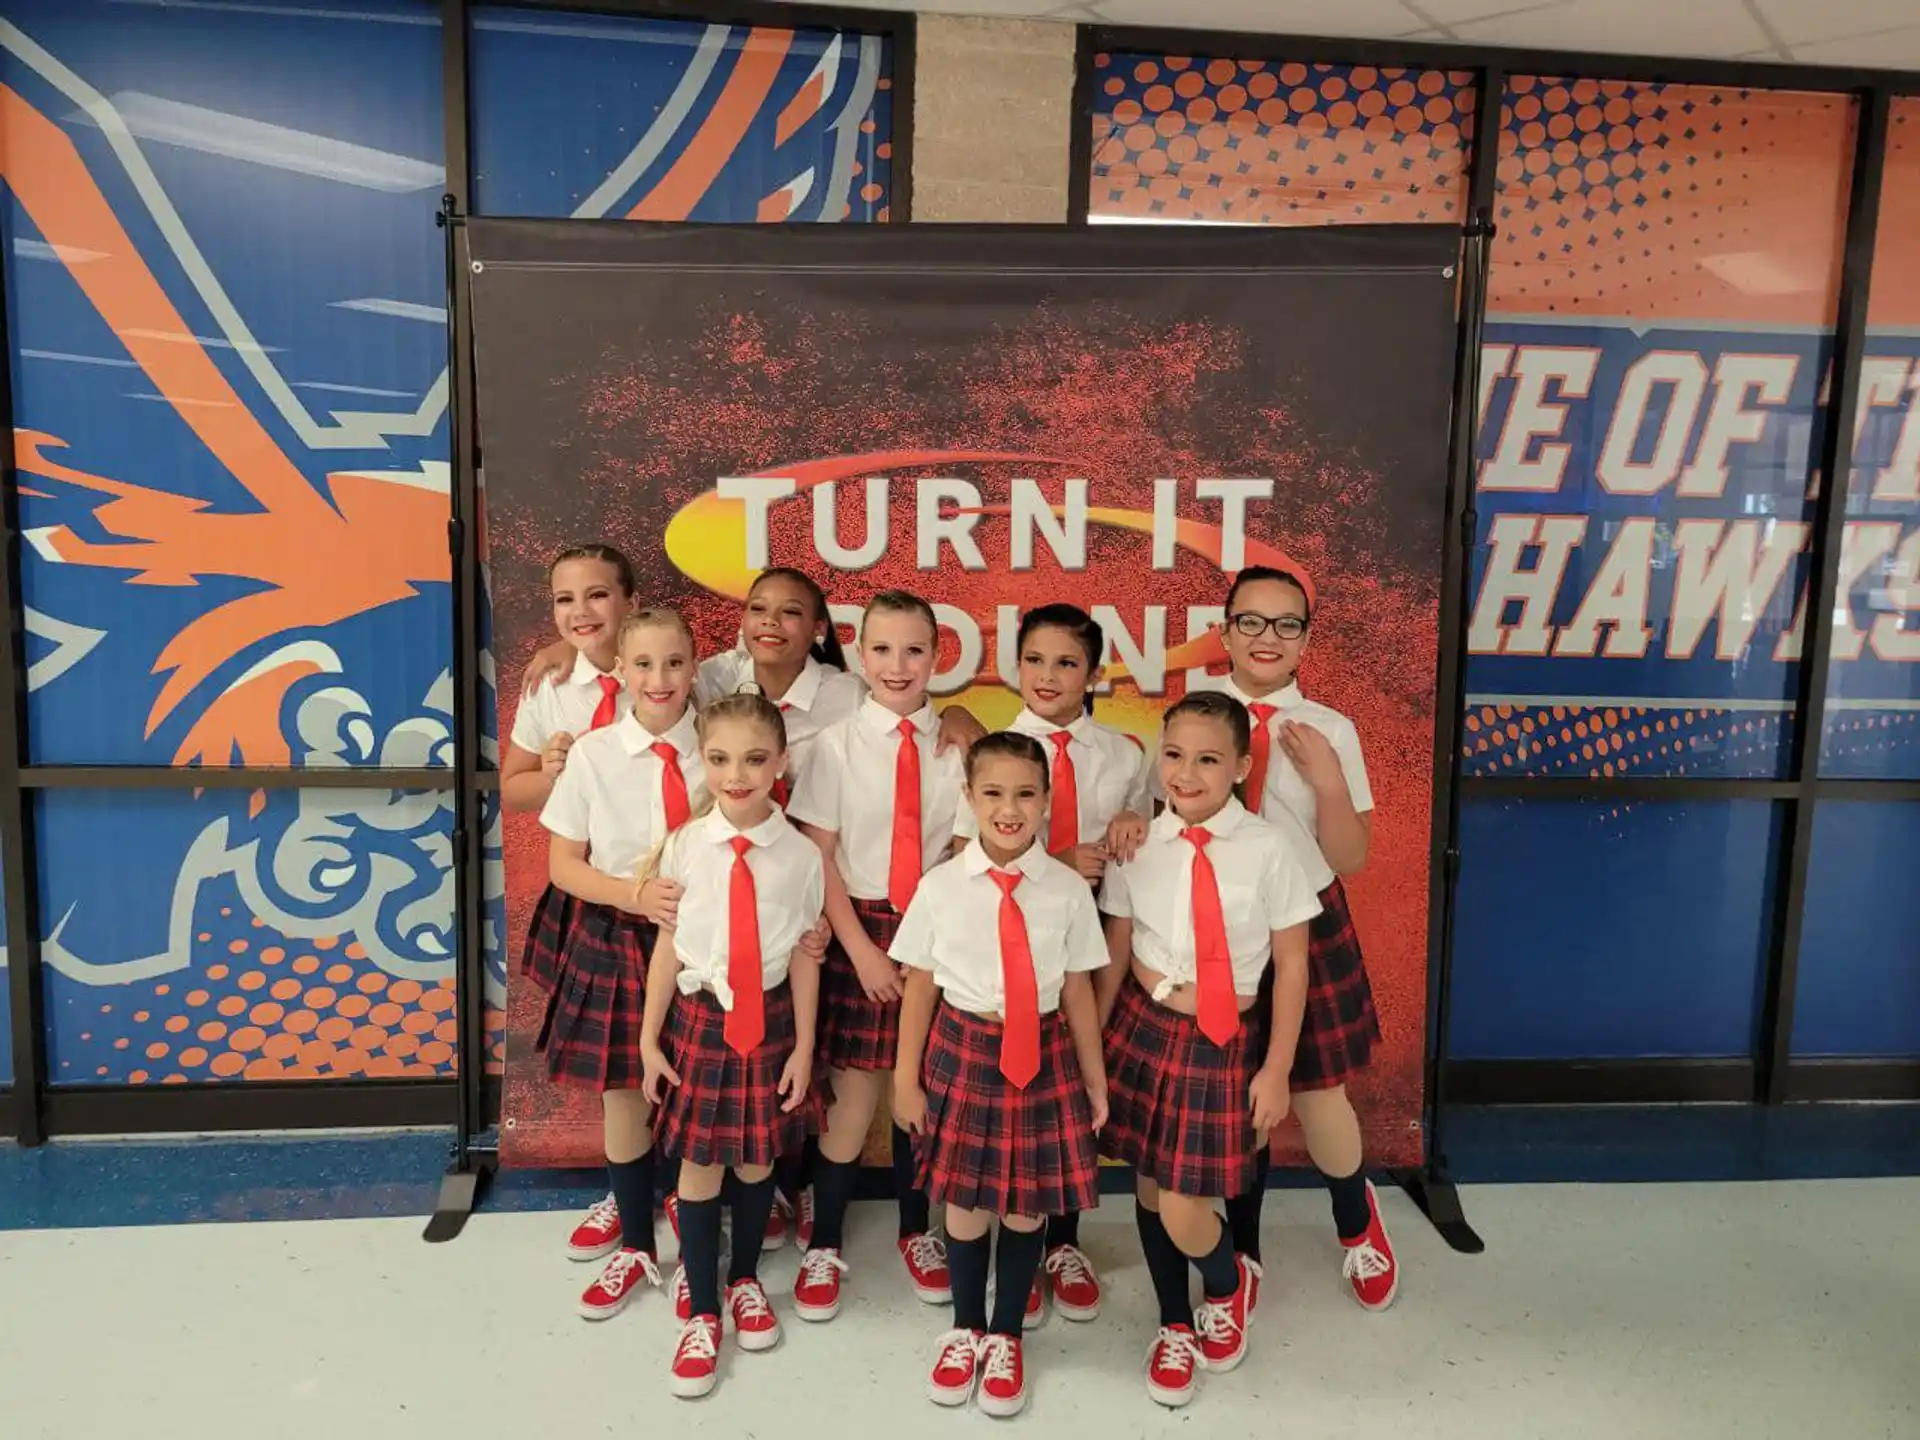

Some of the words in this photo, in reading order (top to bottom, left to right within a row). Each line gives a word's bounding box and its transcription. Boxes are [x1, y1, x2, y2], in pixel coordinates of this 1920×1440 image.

[1595, 350, 1801, 497] OF
[716, 476, 1089, 570] TURN
[1151, 478, 1275, 571] IT
